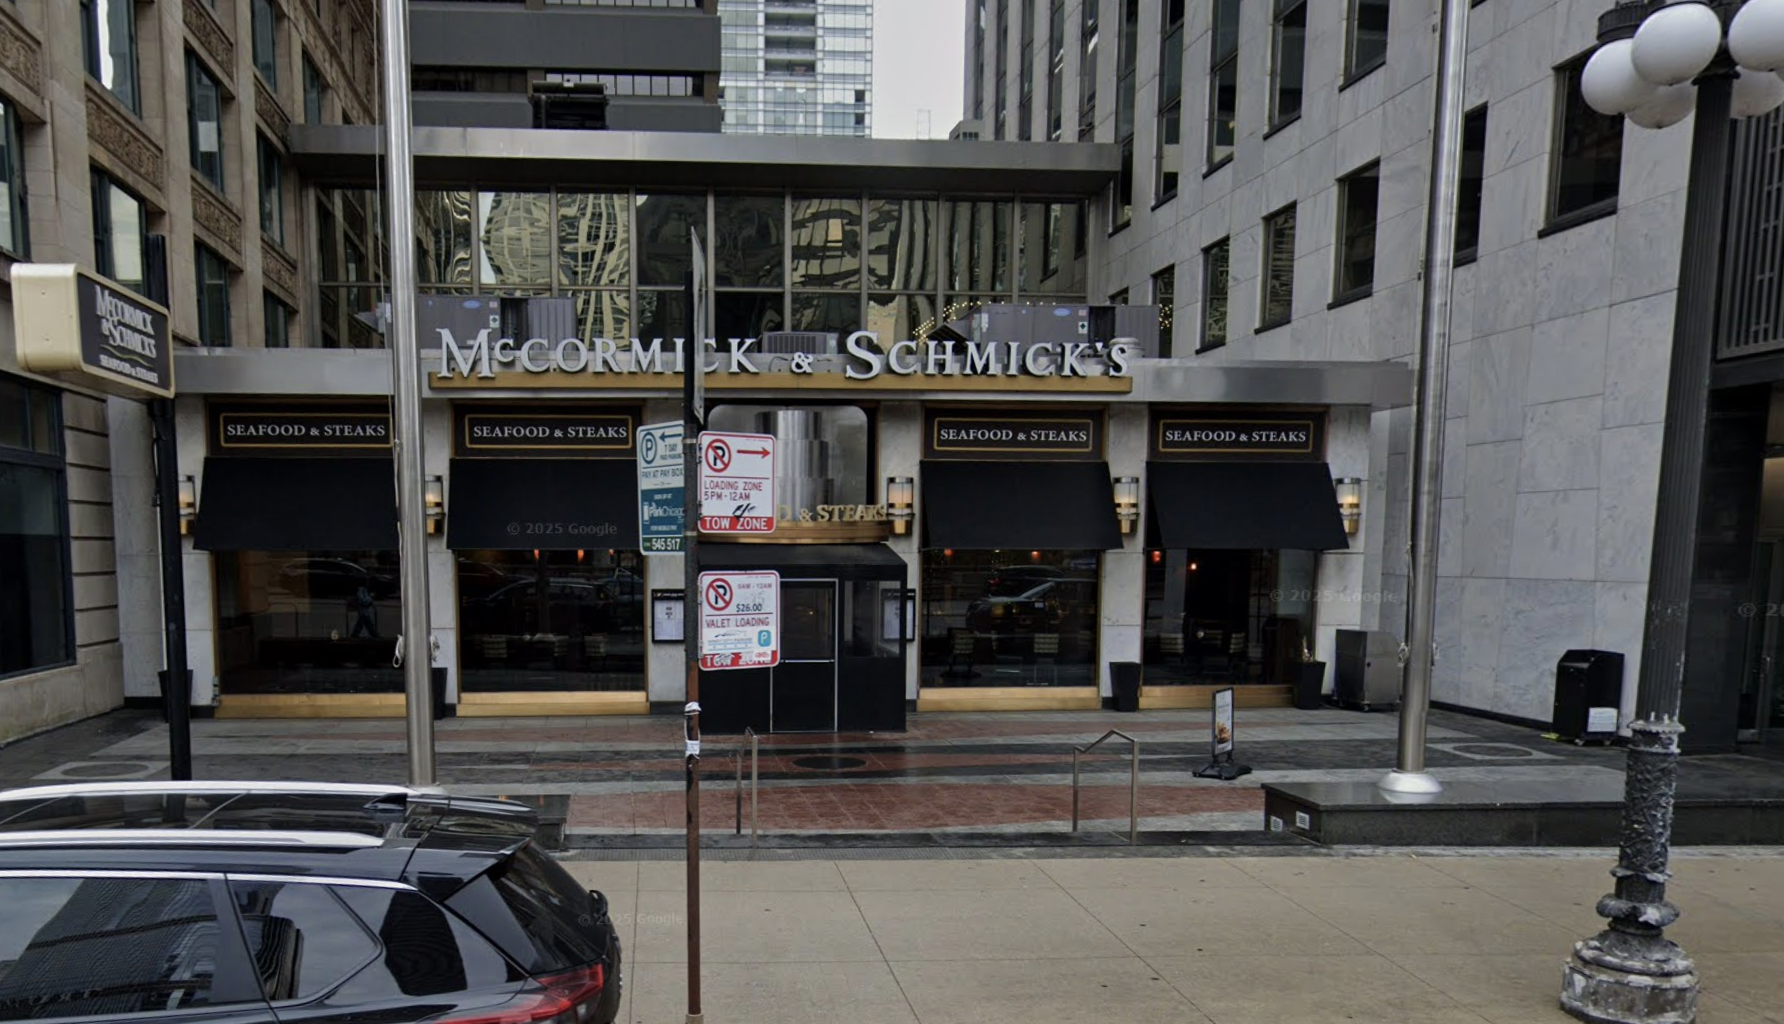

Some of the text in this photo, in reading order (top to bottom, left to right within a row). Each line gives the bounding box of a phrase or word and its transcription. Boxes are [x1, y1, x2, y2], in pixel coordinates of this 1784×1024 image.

[790, 351, 813, 374] &
[845, 330, 1128, 379] SCHMICK'S
[227, 424, 385, 437] SEAFOOD & STEAKS
[473, 426, 627, 438] SEAFOOD & STEAKS
[940, 429, 1087, 442] SEAFOOD & STEAKS
[1165, 430, 1306, 442] SEAFOOD & STEAKS
[642, 468, 683, 478] PAY AT PAY BOX
[704, 480, 763, 491] LOADING ZONE
[704, 491, 723, 501] 5PM
[730, 491, 750, 501] 12AM
[799, 507, 813, 522] &
[816, 504, 887, 522] STEAKS
[704, 517, 768, 530] TOW ZONE
[651, 538, 681, 550] 545 517
[736, 603, 763, 612] $26.00
[705, 617, 770, 628] VALET LOADING
